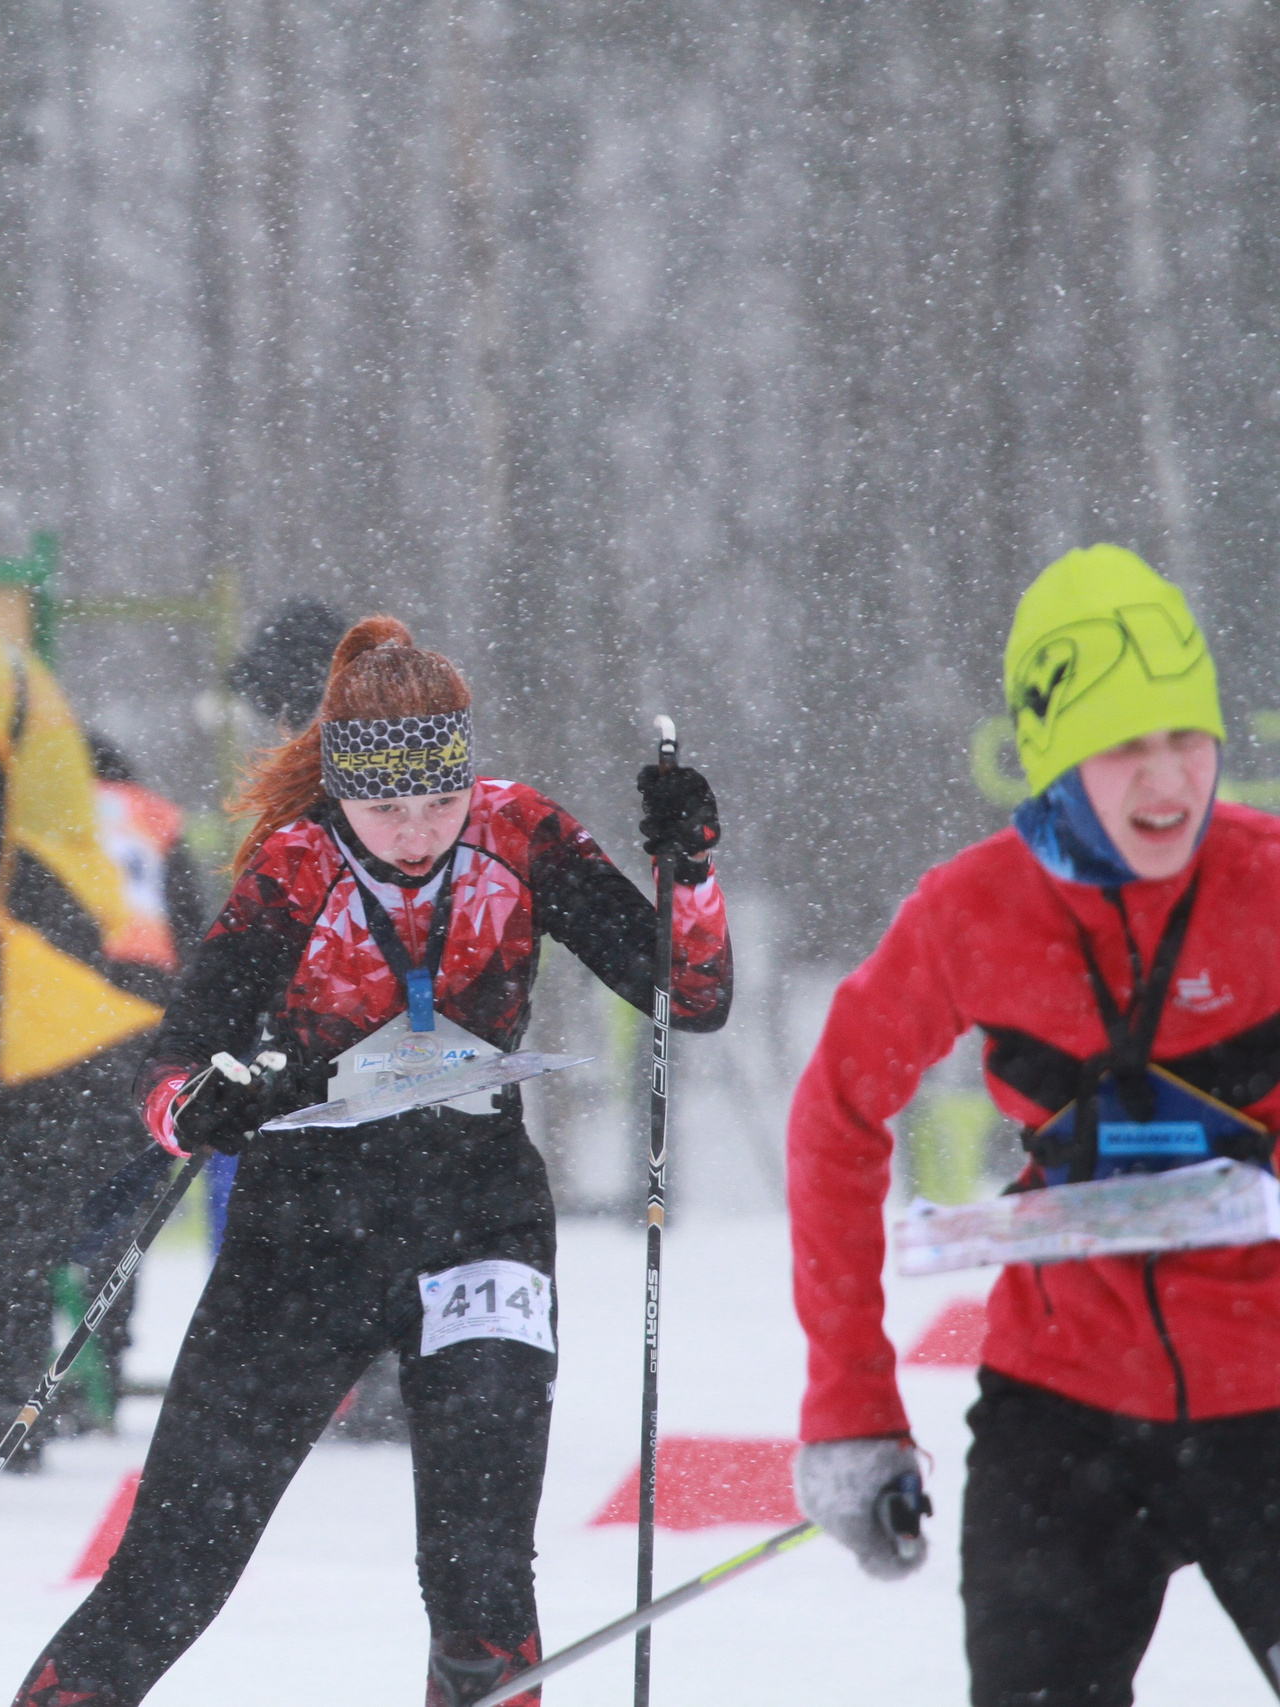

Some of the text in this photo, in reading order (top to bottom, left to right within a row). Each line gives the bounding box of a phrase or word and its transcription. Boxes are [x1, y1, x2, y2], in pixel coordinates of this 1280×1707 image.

[652, 989, 668, 1095] STC
[86, 1244, 141, 1329] STC
[442, 1279, 534, 1319] 414
[646, 1268, 658, 1347] SPORT
